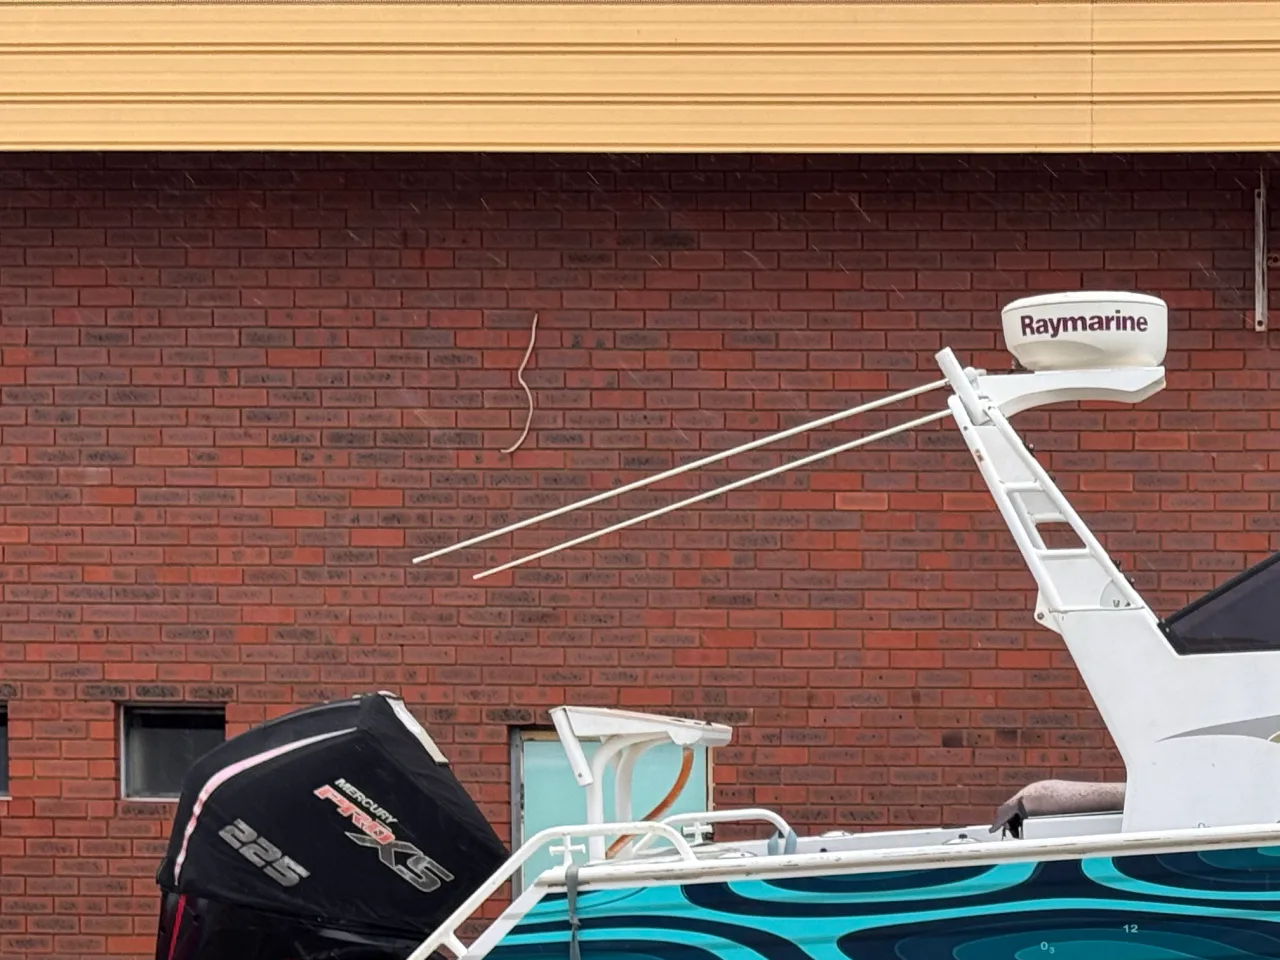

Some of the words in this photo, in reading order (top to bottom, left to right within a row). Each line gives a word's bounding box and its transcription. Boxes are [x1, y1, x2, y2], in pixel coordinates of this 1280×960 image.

[1020, 309, 1149, 338] Raymarine
[312, 784, 397, 845] PRO
[334, 777, 399, 825] MERCURY
[217, 818, 311, 888] 225
[343, 830, 455, 893] XS
[1122, 924, 1139, 933] 12
